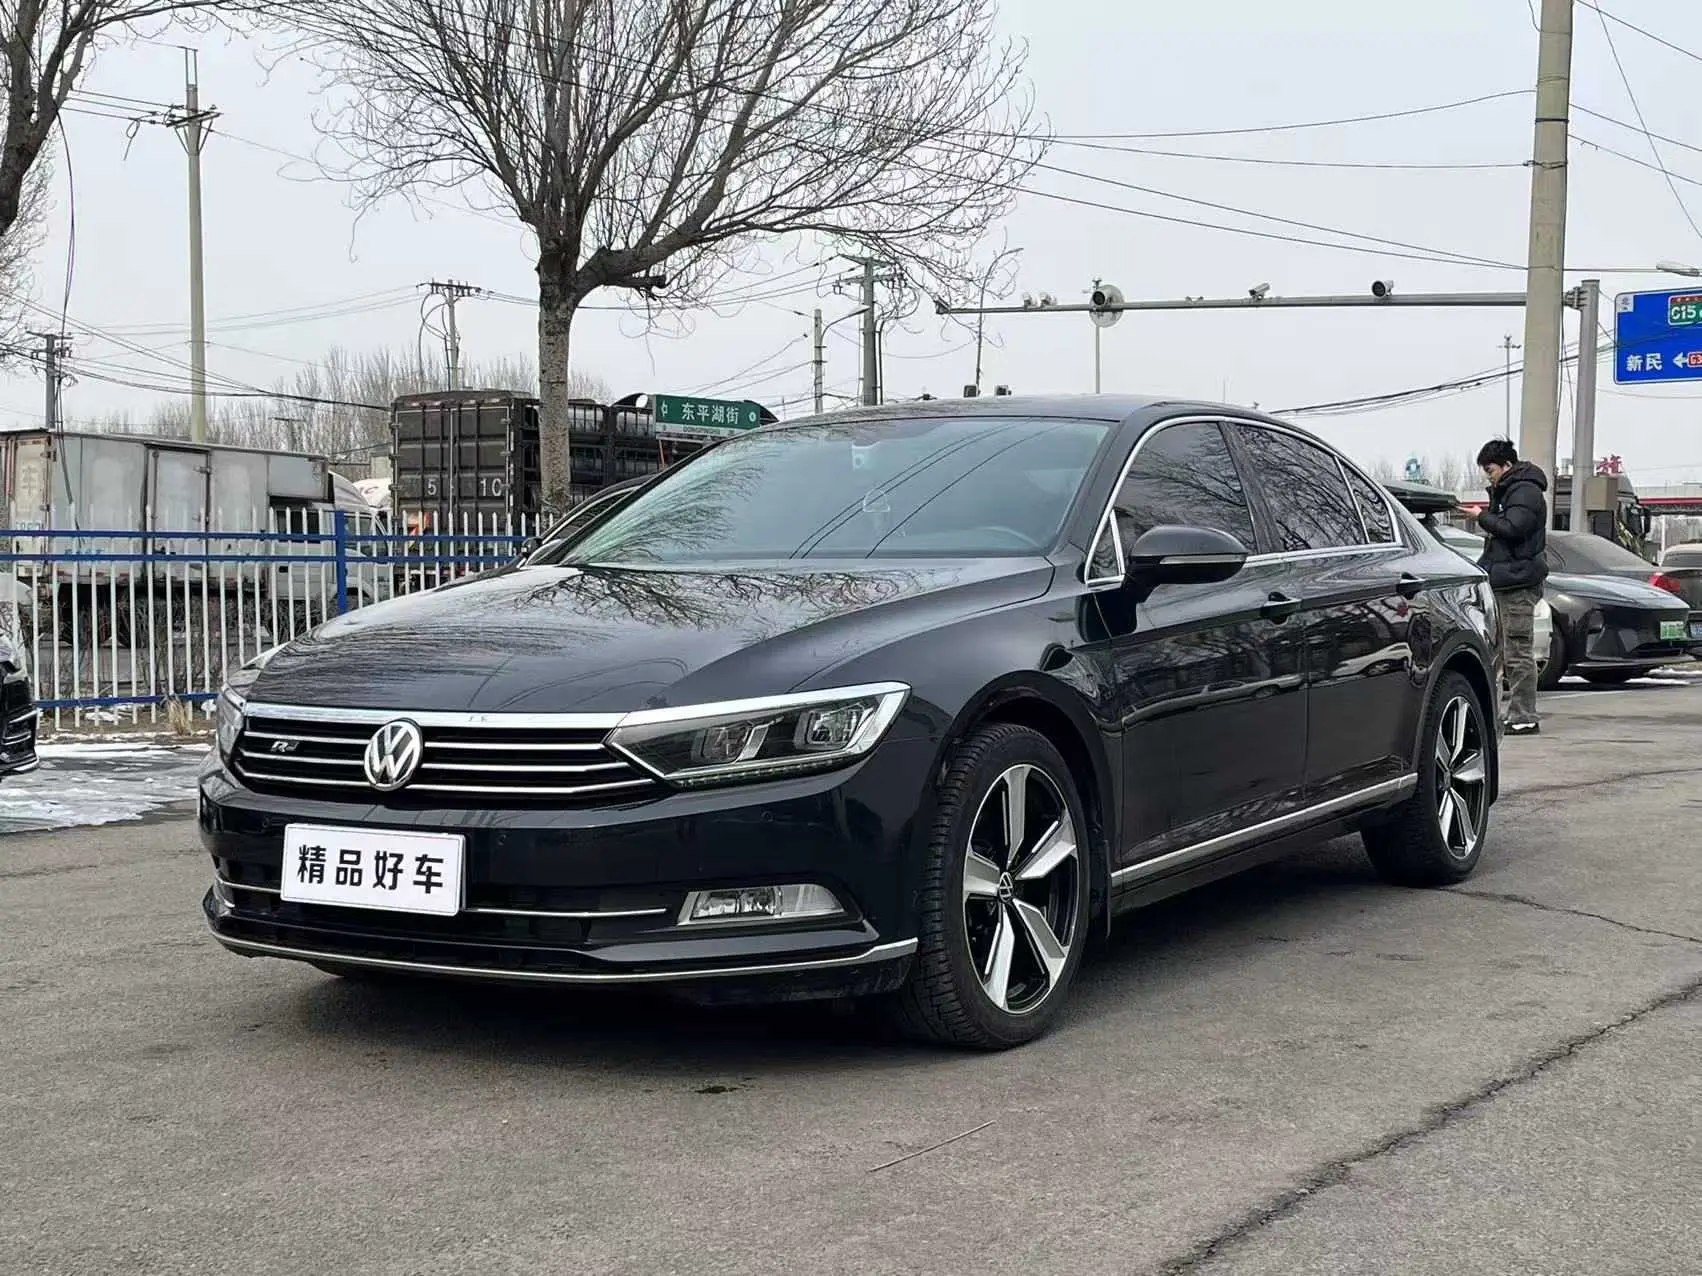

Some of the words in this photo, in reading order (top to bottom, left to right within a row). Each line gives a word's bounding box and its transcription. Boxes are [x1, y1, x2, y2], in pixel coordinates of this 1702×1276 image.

[1627, 353, 1662, 372] 新民
[682, 403, 738, 424] 东平湖街
[427, 478, 437, 496] 5
[297, 844, 444, 894] 精品好车
